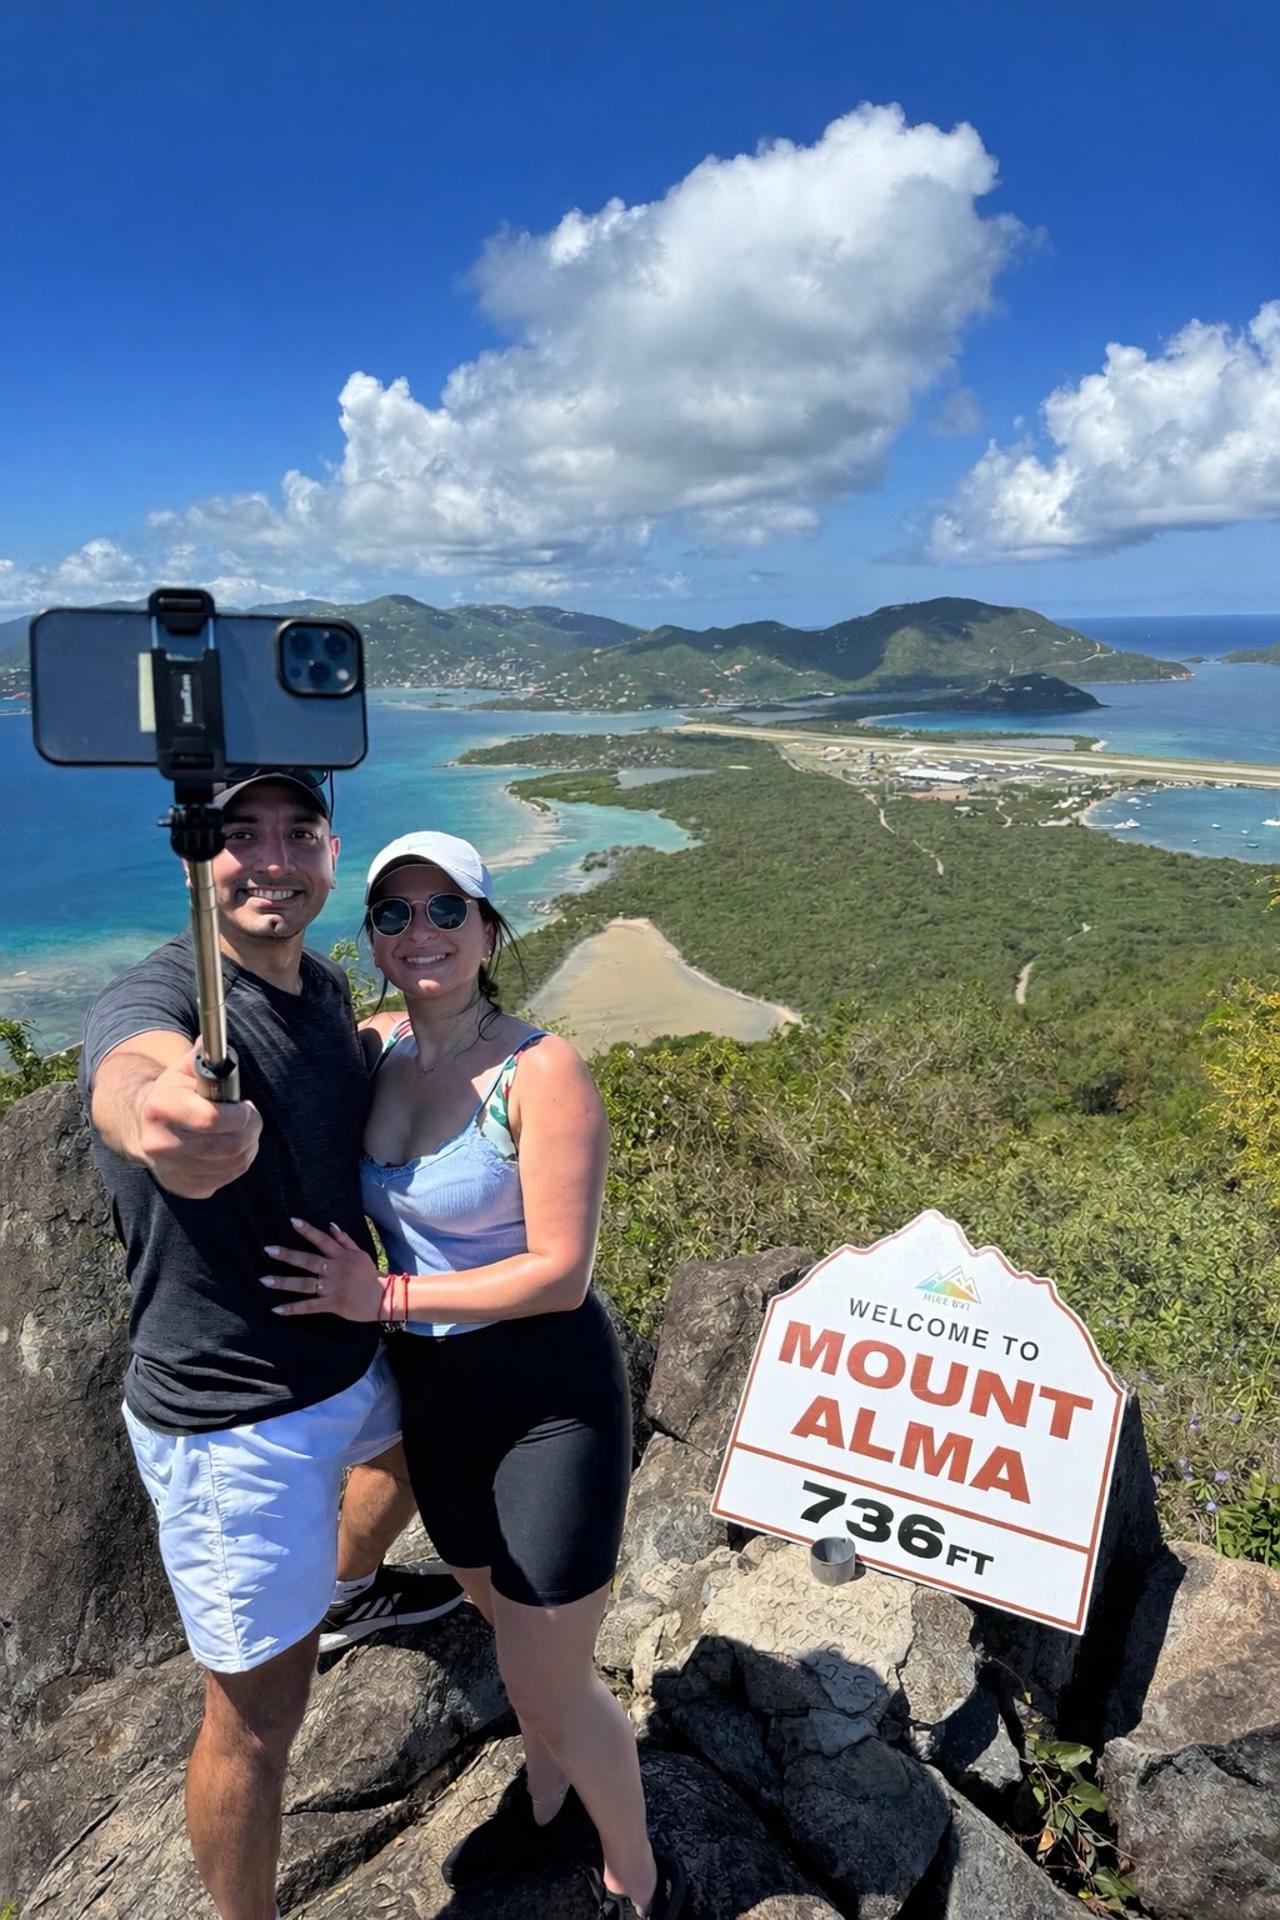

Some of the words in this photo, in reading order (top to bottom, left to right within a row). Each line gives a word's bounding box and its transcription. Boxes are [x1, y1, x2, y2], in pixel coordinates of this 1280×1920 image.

[778, 1320, 1093, 1440] MOUNT
[850, 1297, 989, 1349] WELCOME
[1002, 1335, 1039, 1361] TO
[791, 1395, 1031, 1504] ALMA
